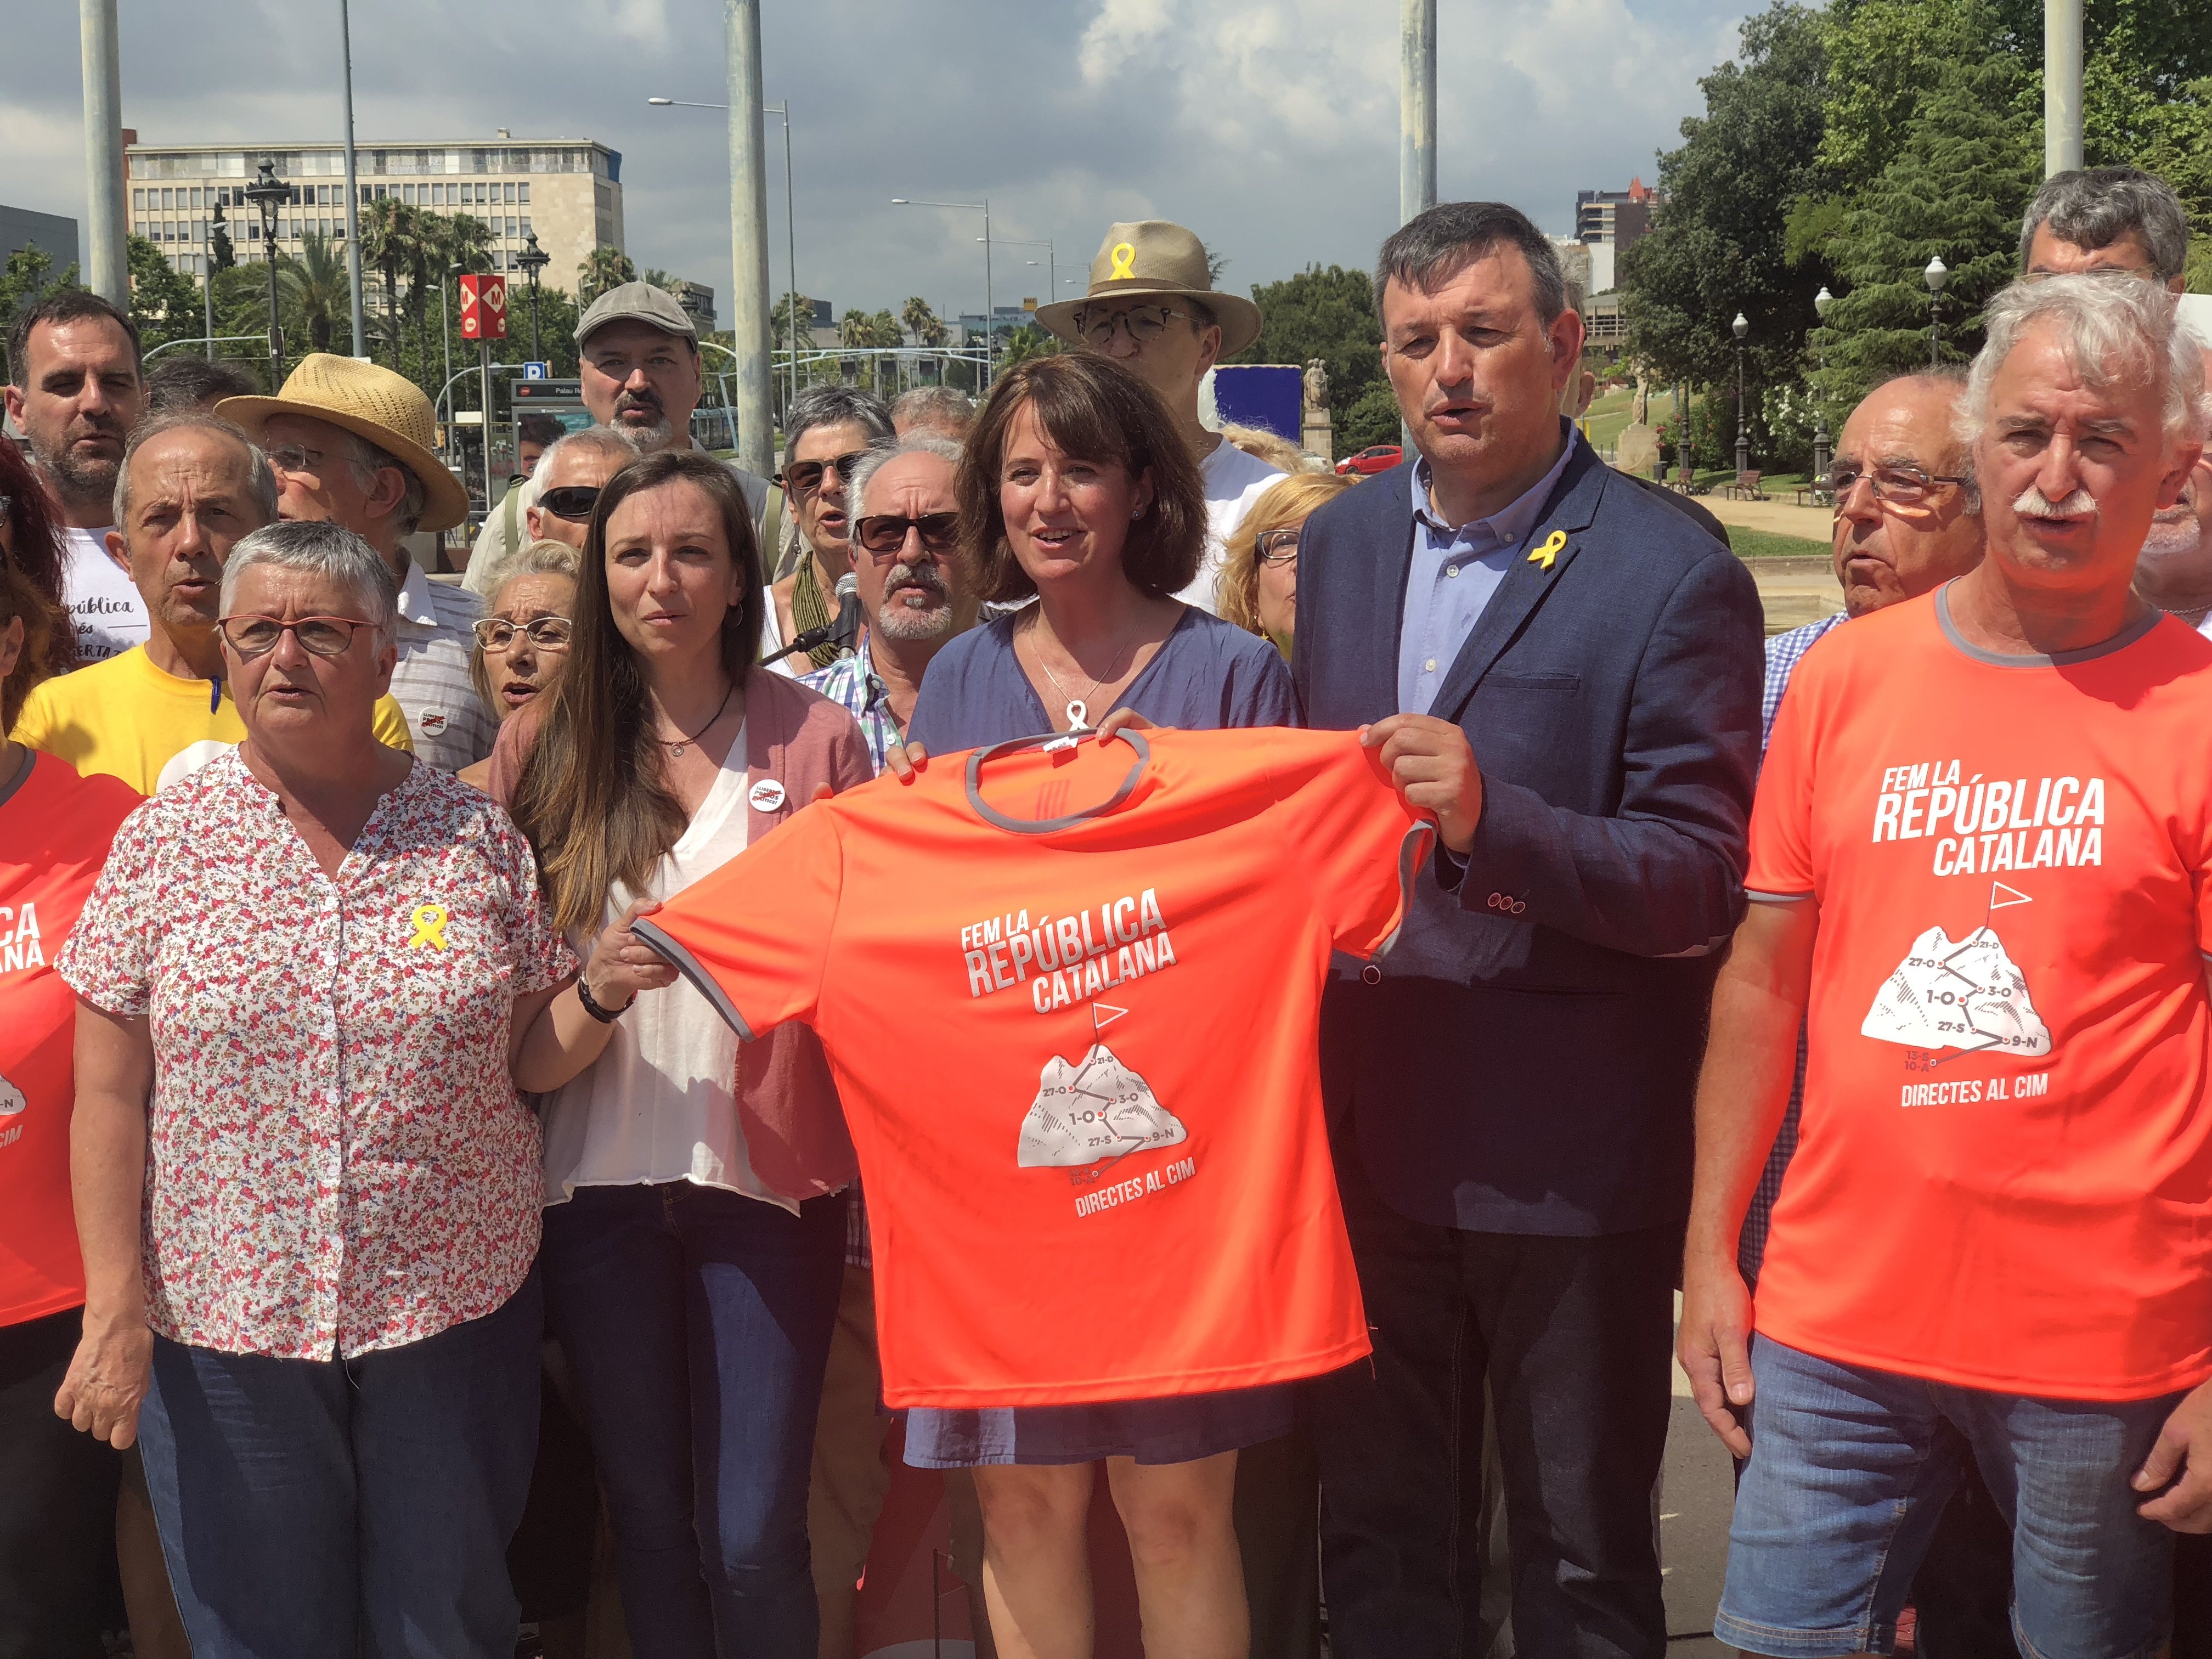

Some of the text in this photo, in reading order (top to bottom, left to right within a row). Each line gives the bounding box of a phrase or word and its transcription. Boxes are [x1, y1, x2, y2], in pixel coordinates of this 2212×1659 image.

[492, 291, 500, 304] M
[1881, 759, 1960, 793] FEM LA
[754, 791, 779, 800] PROS
[1872, 774, 2104, 843] REPÚBLICA
[1933, 827, 2102, 877] CATALANA
[961, 909, 1029, 952] FEM LA
[964, 888, 1167, 998] REPÚBLICA
[1979, 941, 1999, 949] 21-D
[0, 940, 46, 974] NA
[1032, 930, 1177, 1014] CATALANA
[1938, 1022, 1965, 1033] 27-S
[2012, 1036, 2038, 1048] 9-N
[1097, 1056, 1114, 1065] 21-D
[1901, 1073, 2049, 1107] DIRECTES AL CIM
[1088, 1135, 1111, 1147] 27-S
[1152, 1128, 1175, 1142] 9-N
[1075, 1156, 1196, 1217] DIRECTES AL CIM
